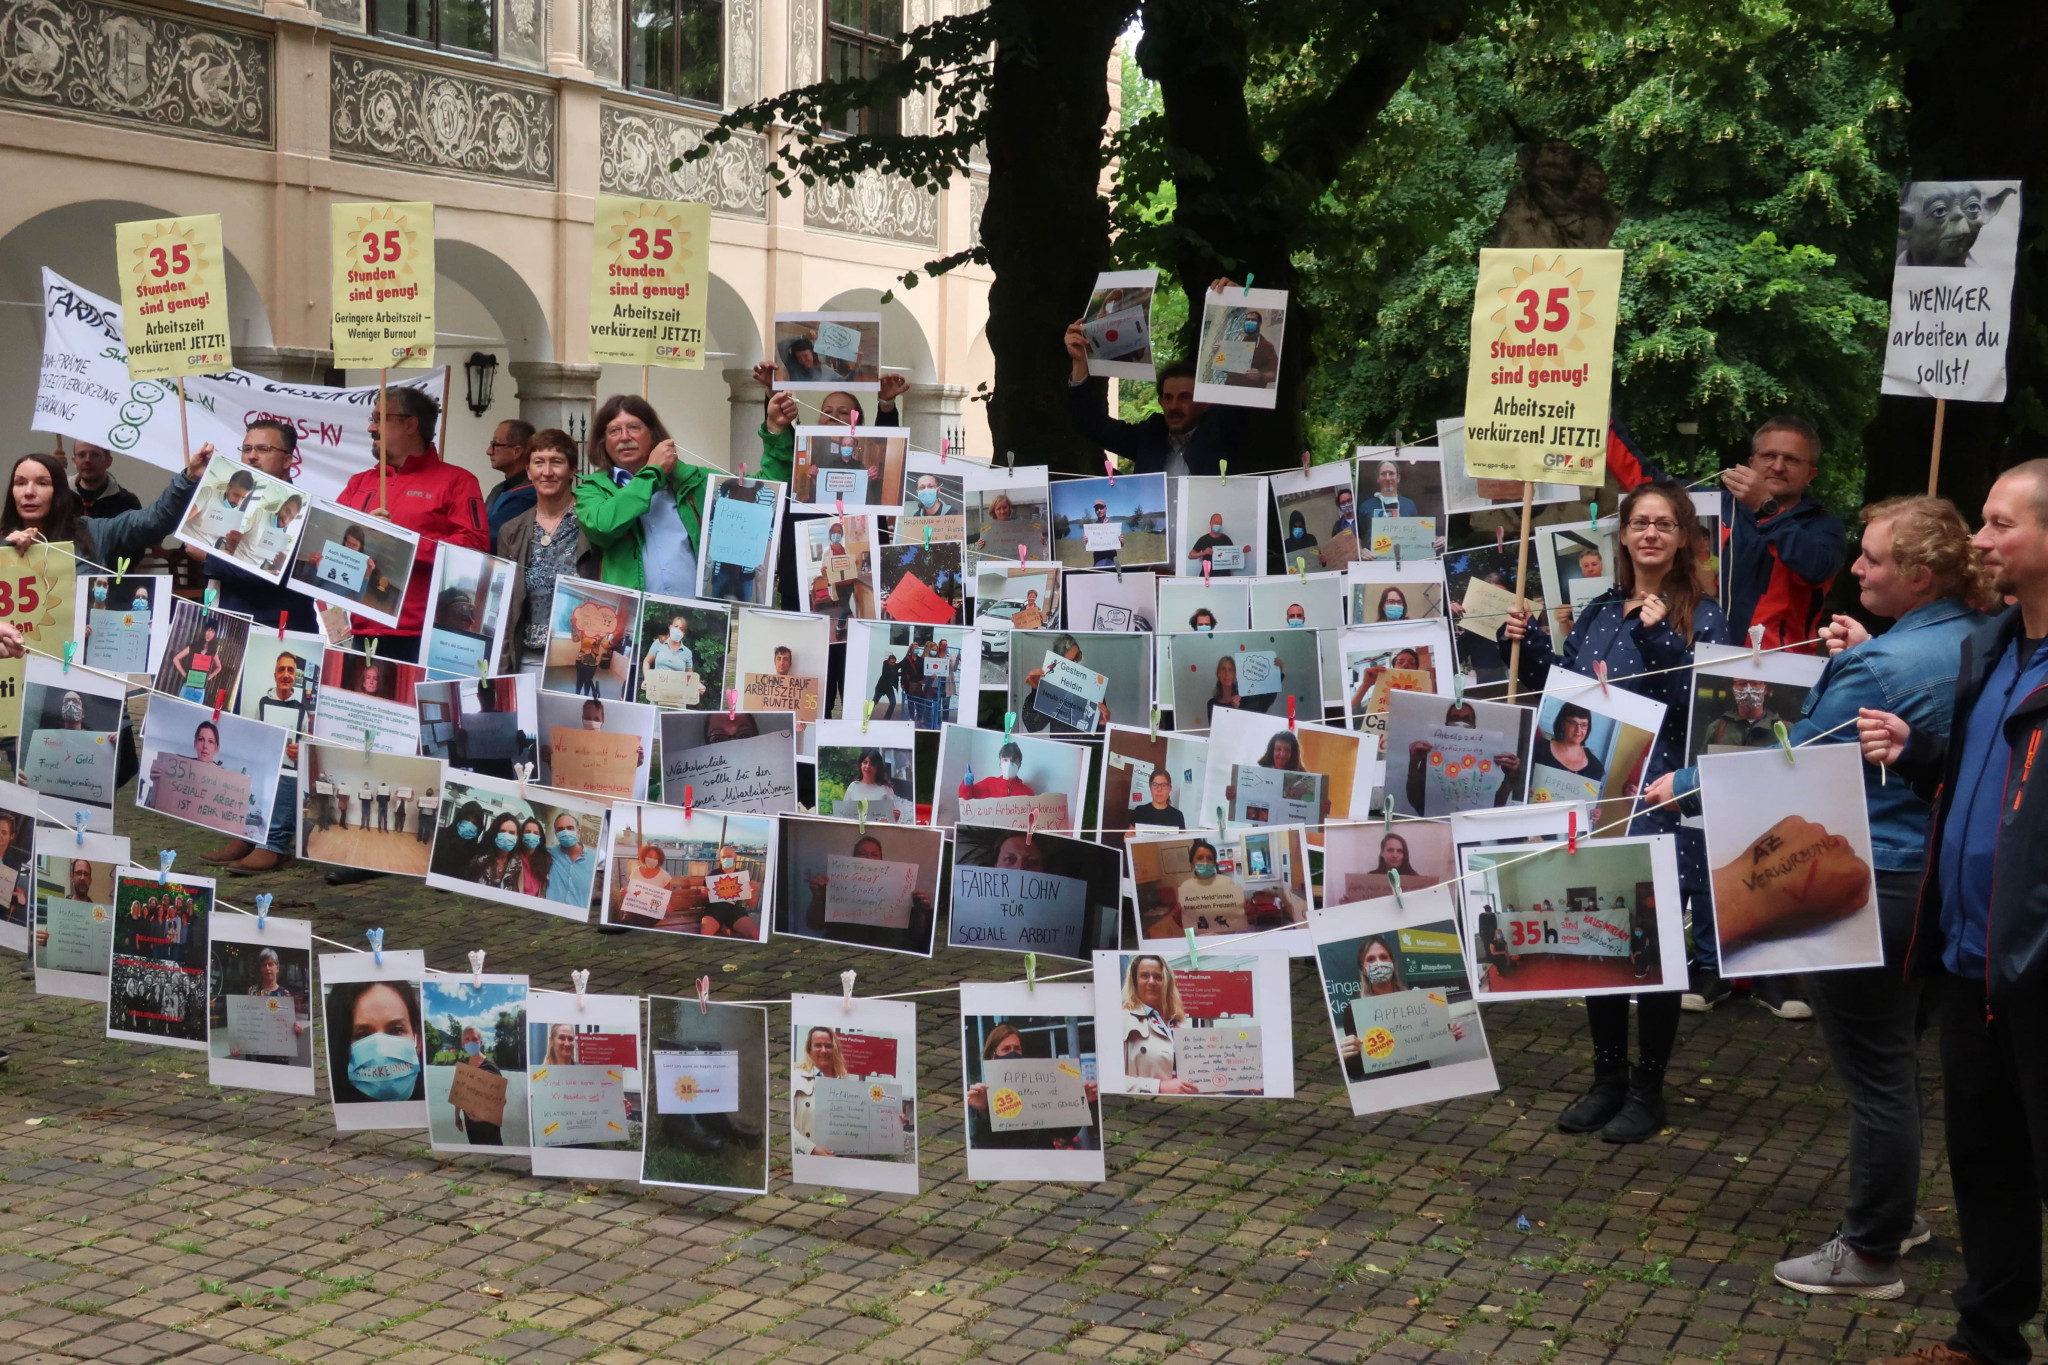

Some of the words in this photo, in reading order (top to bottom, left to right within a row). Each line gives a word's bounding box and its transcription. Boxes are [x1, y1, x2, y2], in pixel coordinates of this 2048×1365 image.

[362, 230, 402, 264] 35
[628, 228, 674, 261] 35
[149, 243, 191, 278] 35
[608, 263, 665, 278] Stunden
[347, 267, 396, 284] Stunden
[136, 279, 187, 298] Stunden
[349, 286, 373, 302] sind
[376, 282, 419, 303] genug!
[609, 282, 639, 296] sind
[642, 282, 690, 300] genug!
[139, 298, 164, 316] sind
[167, 291, 210, 314] genug!
[1908, 285, 1991, 314] WENIGER
[334, 312, 374, 326] Geringere
[375, 311, 422, 324] Arbeitszeit
[613, 303, 681, 323] Arbeitszeit
[1513, 286, 1570, 334] 35
[145, 318, 205, 336] Arbeitszeit
[347, 327, 381, 342] Weniger
[383, 327, 417, 339] Burnout
[590, 321, 657, 339] verkürzen!
[660, 326, 701, 343] JETZT!
[1892, 321, 1968, 347] arbeiten
[1975, 321, 2000, 348] du
[128, 337, 187, 356] verkürzen!
[189, 333, 226, 350] JETZT!
[1490, 338, 1559, 359] Stunden
[1490, 365, 1523, 385] sind
[1527, 362, 1589, 389] genug!
[1916, 357, 1970, 386] sollst!
[1493, 395, 1576, 420] Arbeitszeit
[1467, 420, 1546, 445] verkürzen!
[1549, 425, 1601, 449] JETZT!
[1376, 538, 1387, 547] 35
[1060, 661, 1087, 680] Gestern
[744, 683, 804, 700] ARBEITSZEIT
[755, 674, 785, 687] LÖHNE
[788, 678, 812, 689] RAUF
[1060, 676, 1083, 693] Heldin
[762, 696, 800, 710] RUNTER
[171, 781, 208, 799] SOZIALE
[213, 793, 244, 810] ARBEIT
[1535, 792, 1548, 802] 35
[177, 799, 192, 811] IST
[197, 804, 218, 818] MEHR
[221, 810, 245, 825] WERT
[1752, 833, 1785, 866] AZ
[1741, 833, 1841, 893] VERKÜRZUNG
[960, 868, 1010, 899] FAIRER
[1019, 878, 1061, 901] LOHN
[1000, 900, 1025, 918] FÜR
[958, 922, 1008, 944] SOZIALE
[1018, 927, 1060, 943] ARBEIT
[1509, 920, 1559, 947] 35h
[1560, 917, 1579, 930] sind
[1583, 914, 1604, 929] HAUS
[1603, 922, 1631, 943] MIRIAM
[1374, 1003, 1428, 1022] APPLAUS
[1366, 1038, 1395, 1057] STUNDEN
[1367, 1032, 1386, 1049] 35
[1004, 1071, 1057, 1085] APPLAUS
[680, 1084, 693, 1095] 35
[995, 1100, 1022, 1116] STUNDEN
[996, 1093, 1015, 1107] 35
